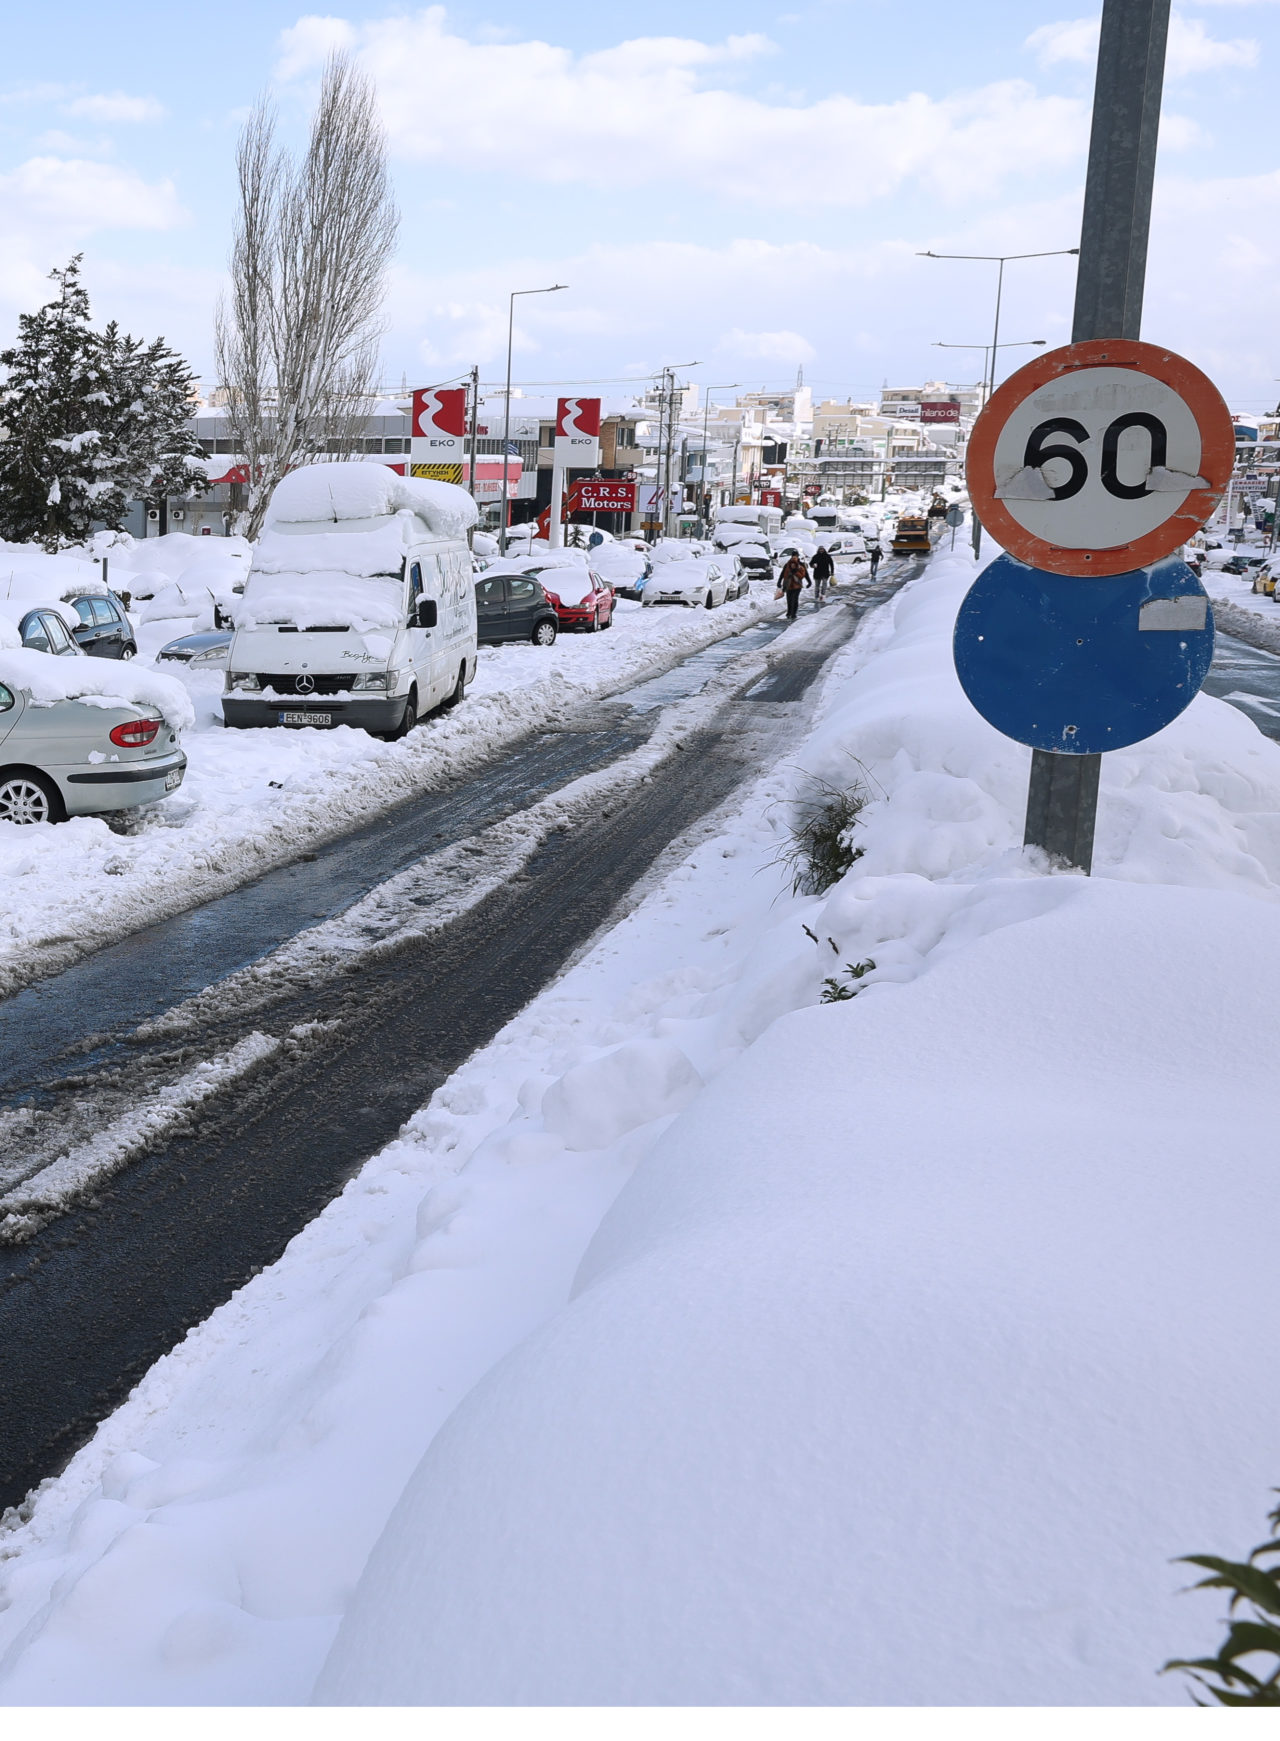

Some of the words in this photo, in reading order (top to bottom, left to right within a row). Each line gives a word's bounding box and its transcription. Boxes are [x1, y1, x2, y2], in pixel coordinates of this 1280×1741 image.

[1024, 412, 1168, 501] 60
[581, 486, 632, 498] C.R.S.
[581, 498, 631, 508] Motors
